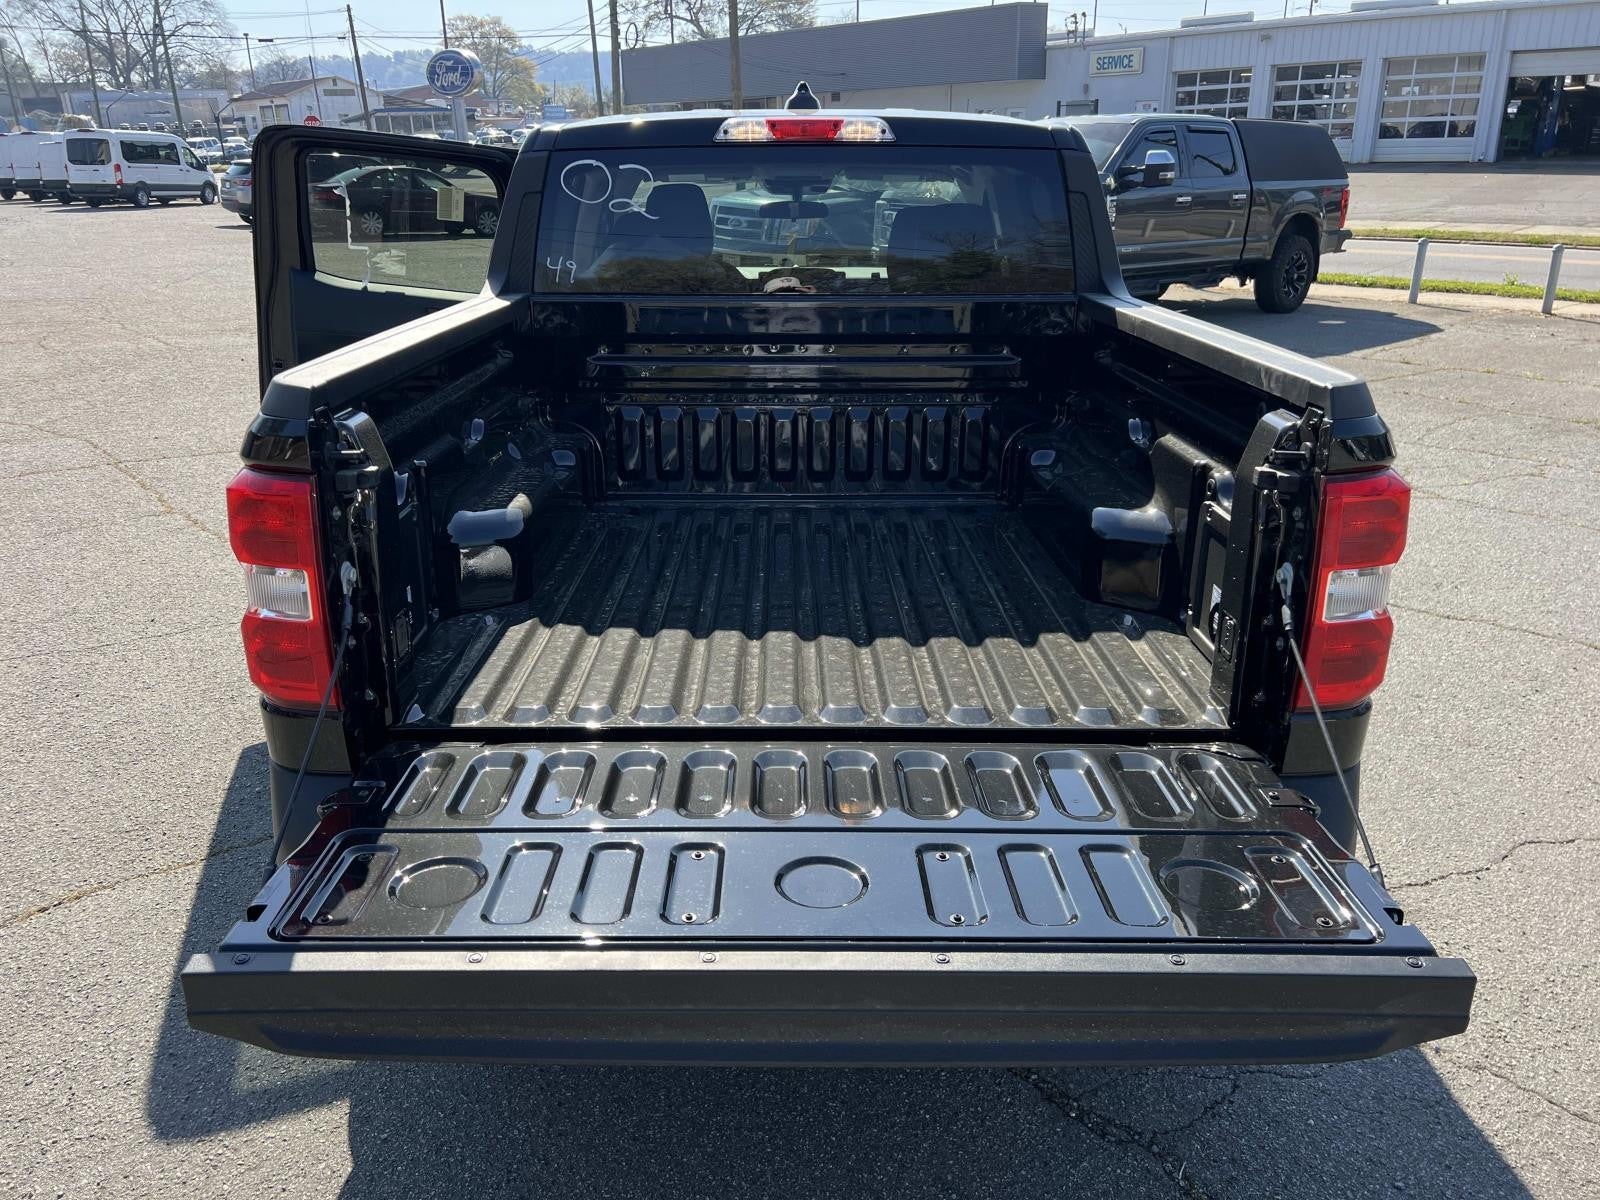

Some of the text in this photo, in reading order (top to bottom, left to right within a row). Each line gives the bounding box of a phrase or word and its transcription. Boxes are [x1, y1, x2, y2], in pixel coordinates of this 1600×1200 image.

[435, 60, 467, 87] Ford
[1096, 54, 1134, 71] SERVICE
[547, 256, 576, 283] 49
